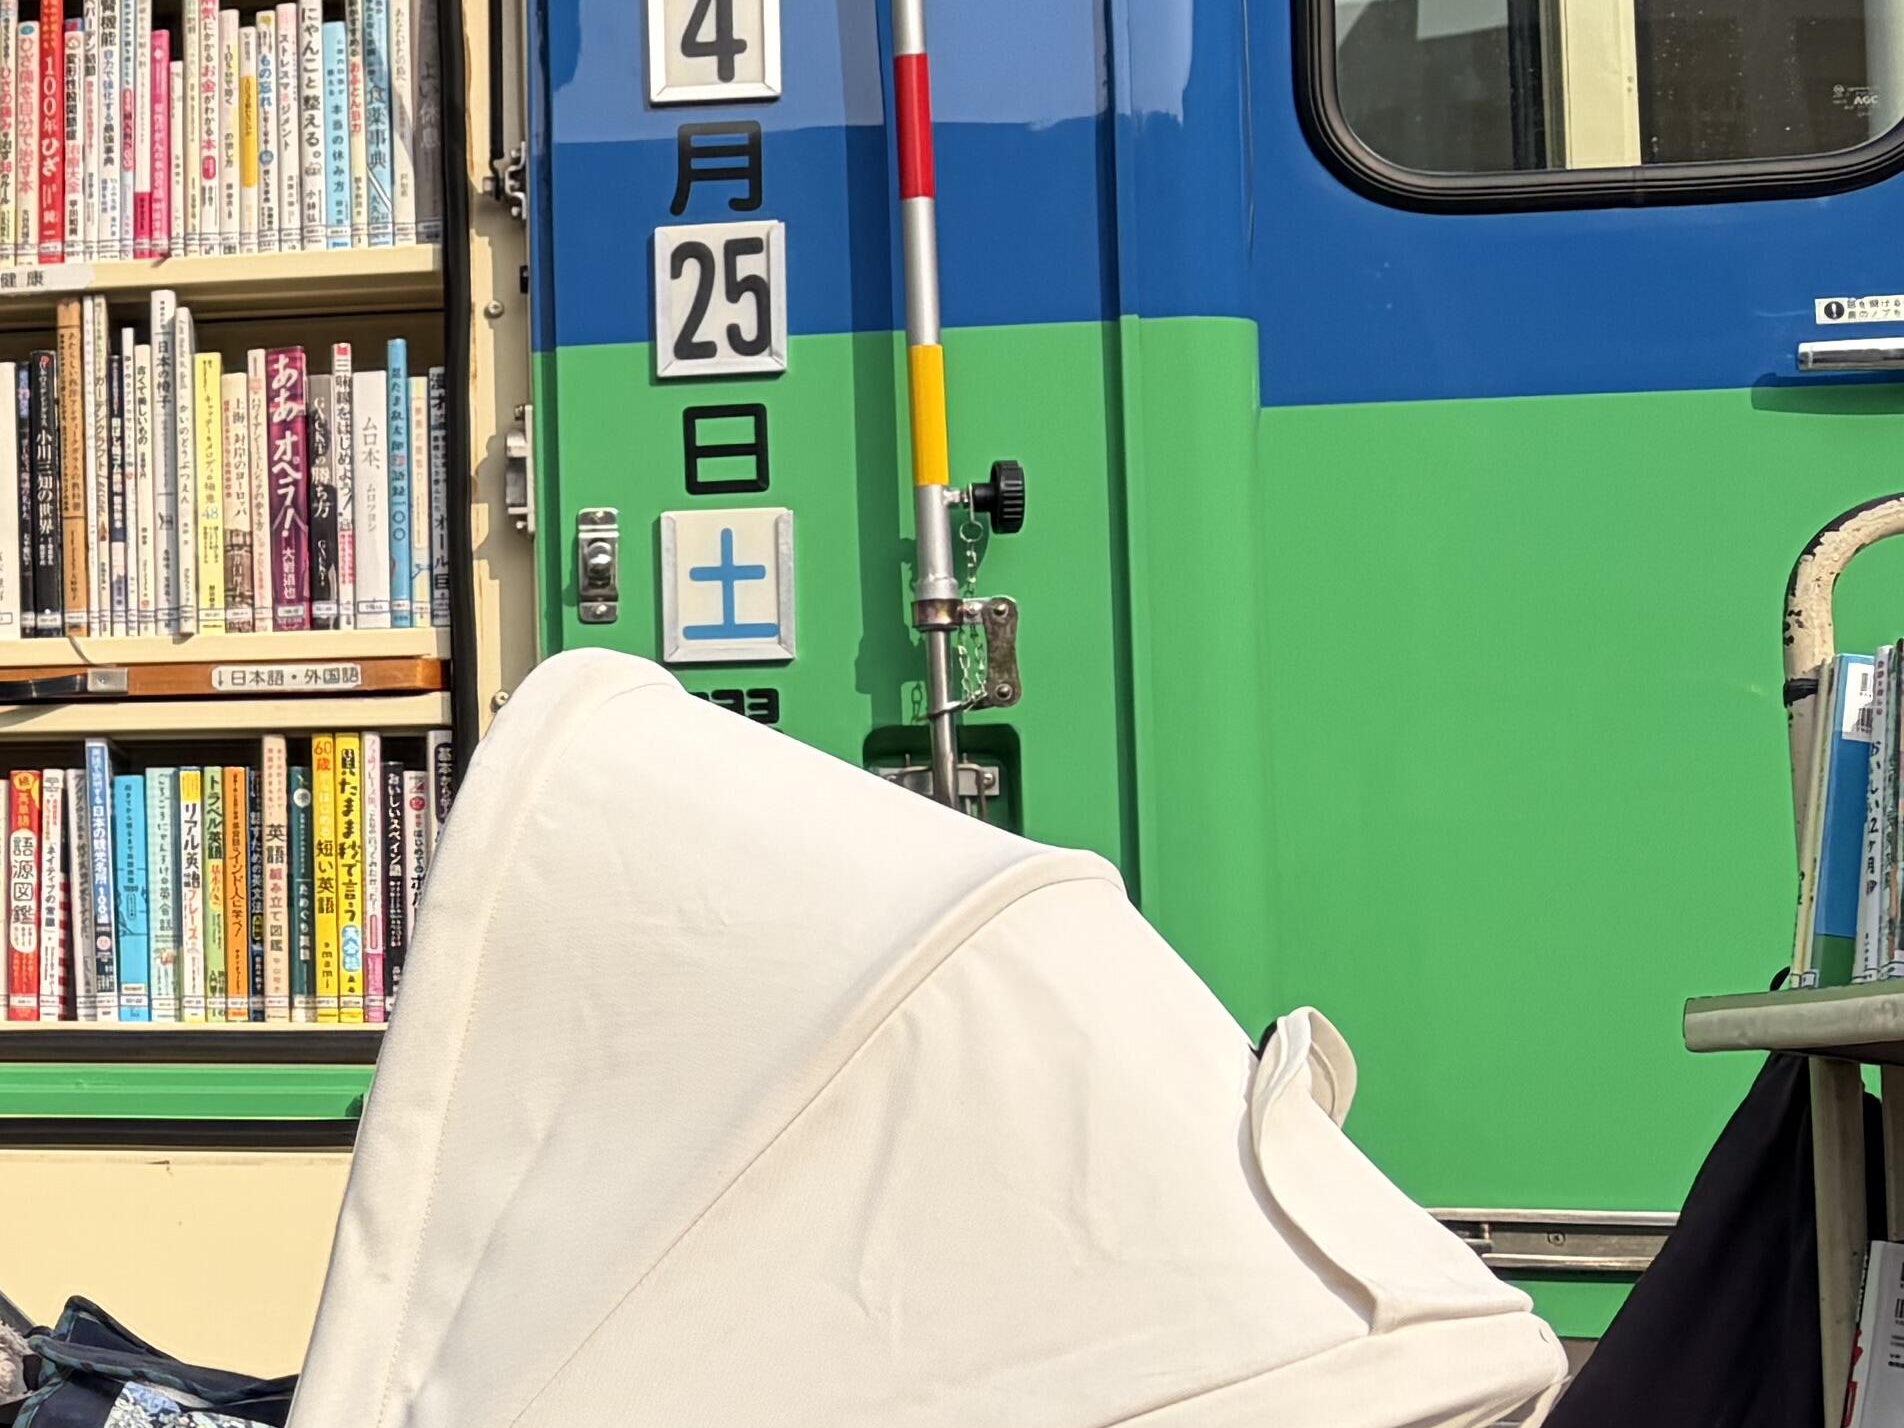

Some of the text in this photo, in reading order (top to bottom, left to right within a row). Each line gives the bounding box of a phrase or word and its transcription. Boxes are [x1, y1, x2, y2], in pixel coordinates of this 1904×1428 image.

[302, 7, 321, 160] にゃんこと整える。
[367, 88, 387, 169] 食薬事典
[331, 105, 346, 194] 本当の休み方
[669, 120, 763, 216] 月
[669, 236, 771, 359] 25
[37, 432, 54, 534] 小川三知の世界
[272, 354, 302, 537] ああ オペラ!
[683, 403, 770, 494] 日
[683, 527, 780, 641] 土
[230, 666, 359, 686] 日本語・外国語
[207, 776, 222, 860] トラベル英語
[13, 836, 33, 925] 語源図鑑
[266, 823, 285, 953] 英語組み立て図鑑
[316, 840, 334, 914] 短い英語
